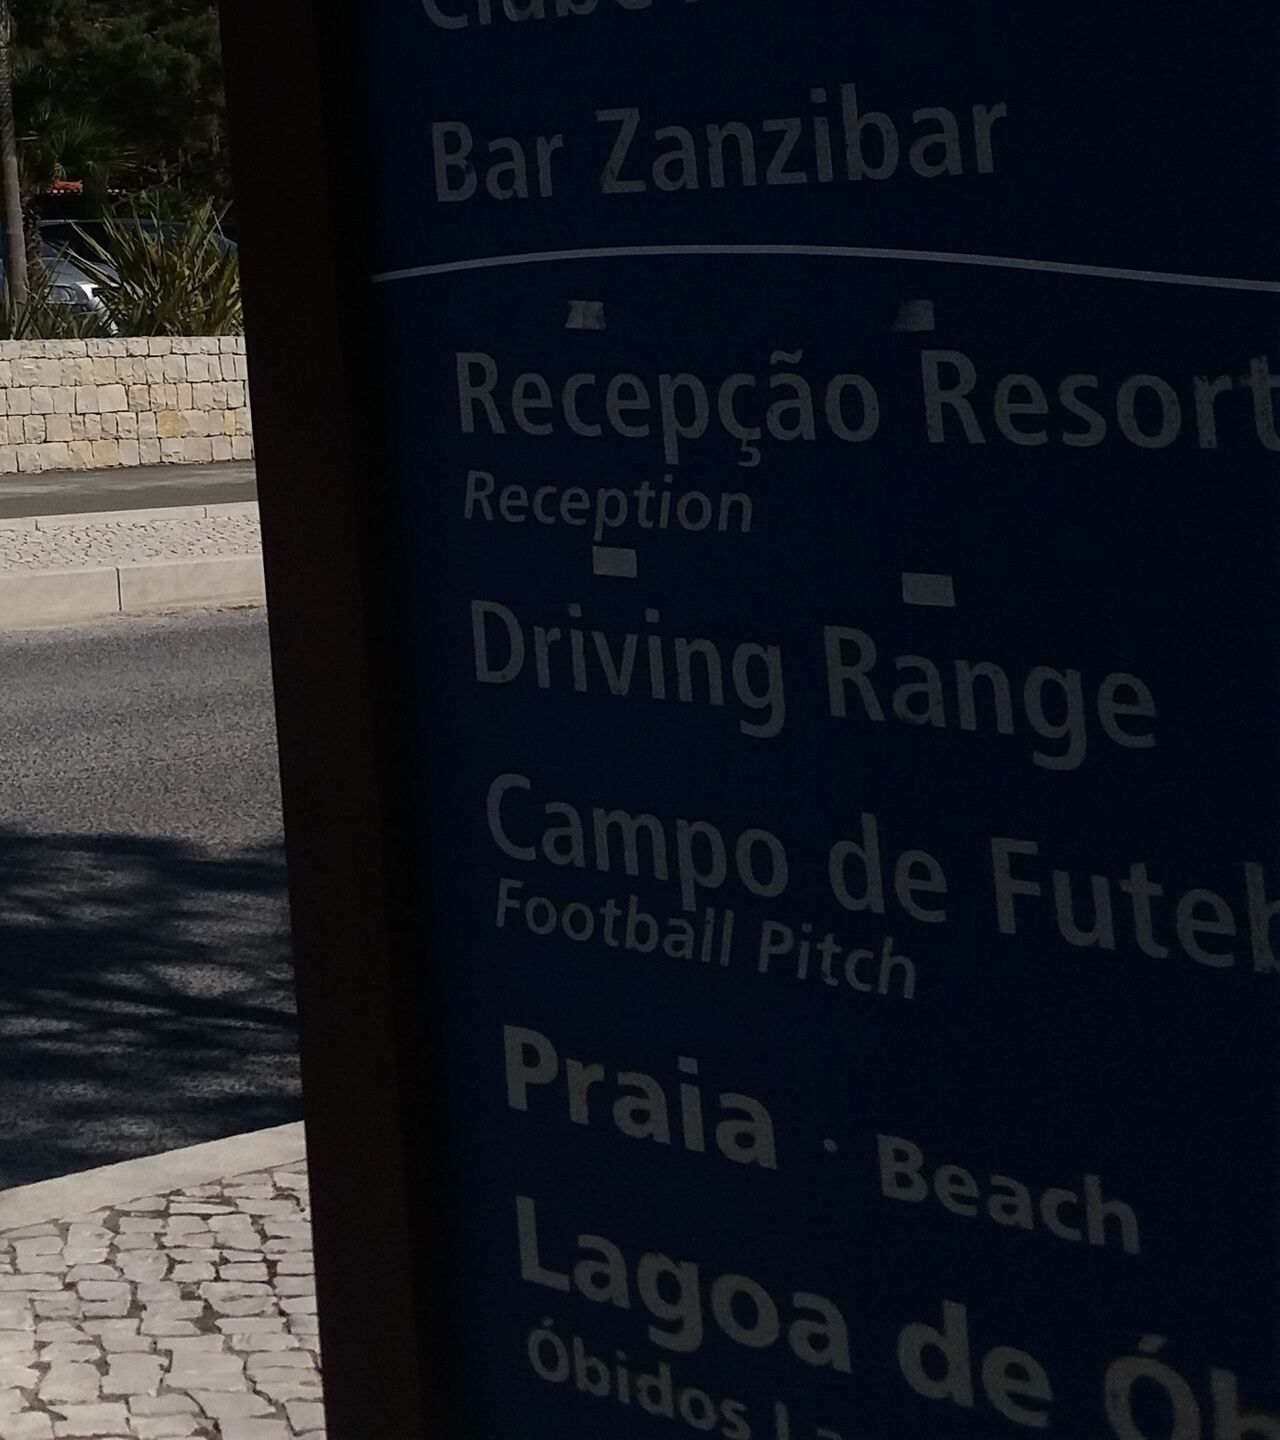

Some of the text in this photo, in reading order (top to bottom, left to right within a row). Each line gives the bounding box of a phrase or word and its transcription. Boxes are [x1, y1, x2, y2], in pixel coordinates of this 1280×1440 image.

[429, 82, 1009, 204] Bar Zanzibar
[454, 348, 1280, 469] Recepção Resort
[462, 469, 755, 542] Reception
[469, 598, 1158, 772] Driving Range
[484, 771, 791, 913] Campo
[828, 812, 949, 925] de
[494, 876, 918, 1001] Football Pitch
[501, 1023, 780, 1172] Praia
[876, 1132, 1143, 1257] Beach
[514, 1192, 854, 1375] Lagoa
[896, 1299, 1055, 1430] de
[526, 1315, 753, 1440] Óbidos
